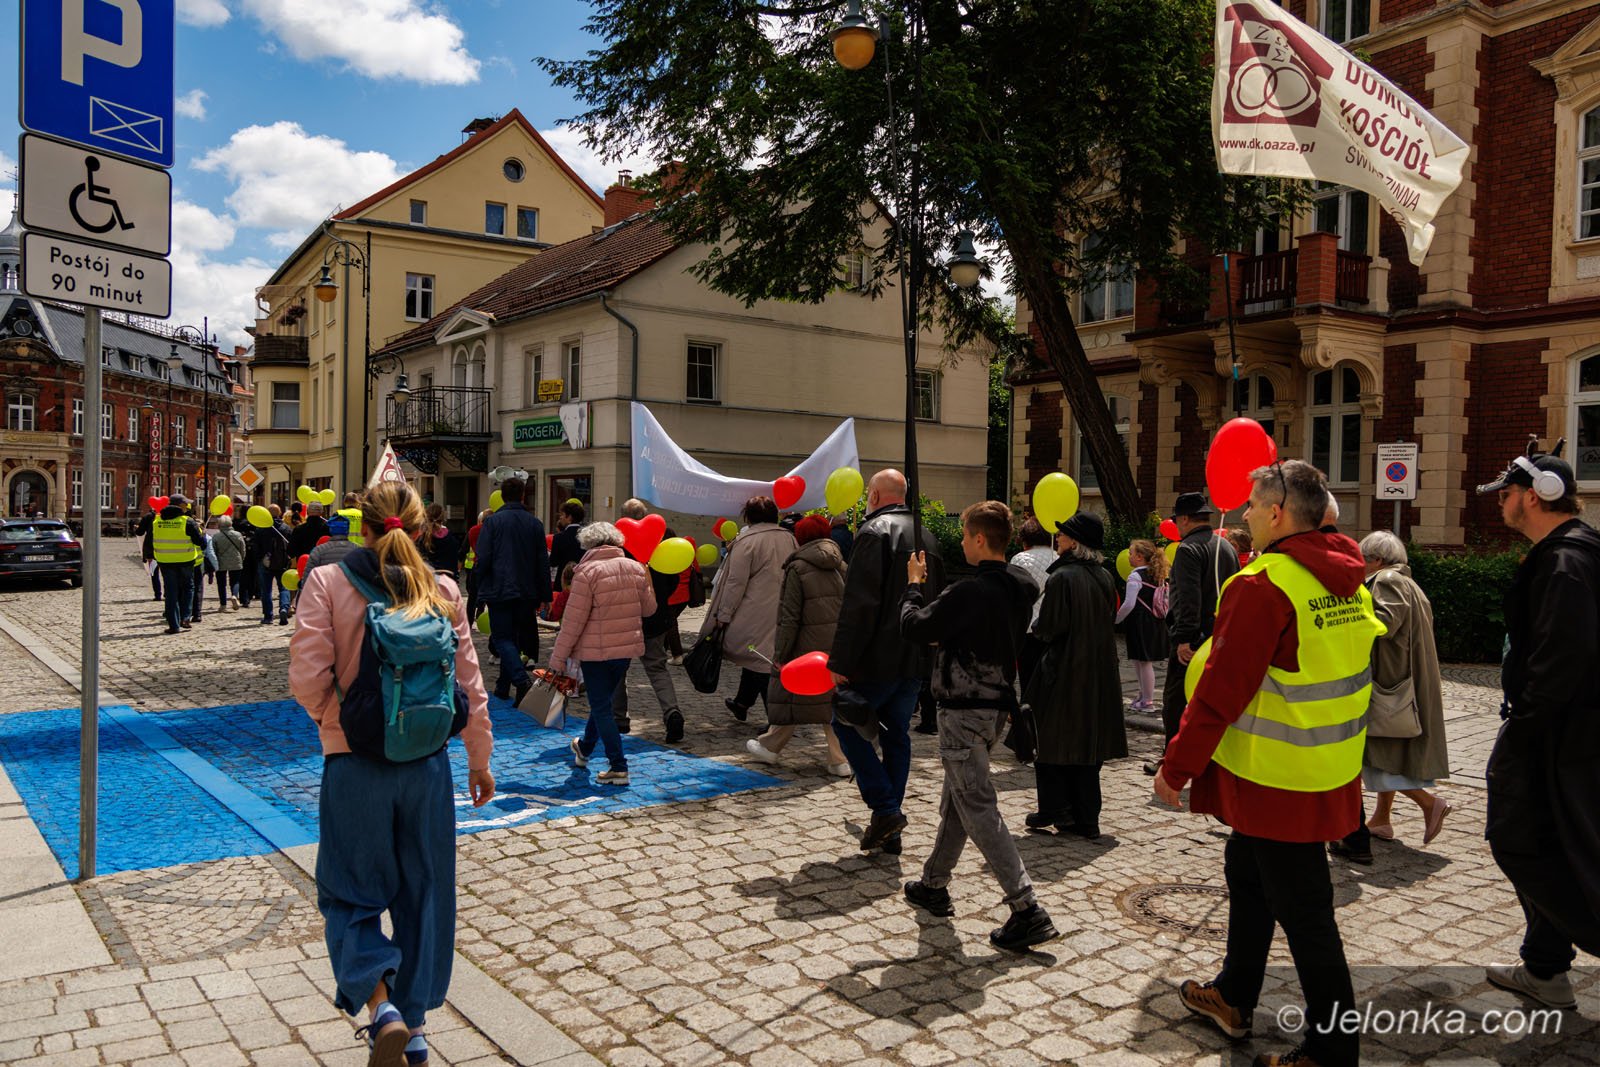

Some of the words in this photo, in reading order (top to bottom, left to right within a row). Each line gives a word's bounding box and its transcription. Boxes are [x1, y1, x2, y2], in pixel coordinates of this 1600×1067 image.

[61, 0, 143, 86] P
[1219, 138, 1316, 154] www.dk.oaza.pl
[50, 246, 109, 277] Postój
[122, 262, 145, 280] do
[51, 274, 76, 292] 90
[89, 285, 143, 304] minut
[151, 417, 160, 485] POCZTA
